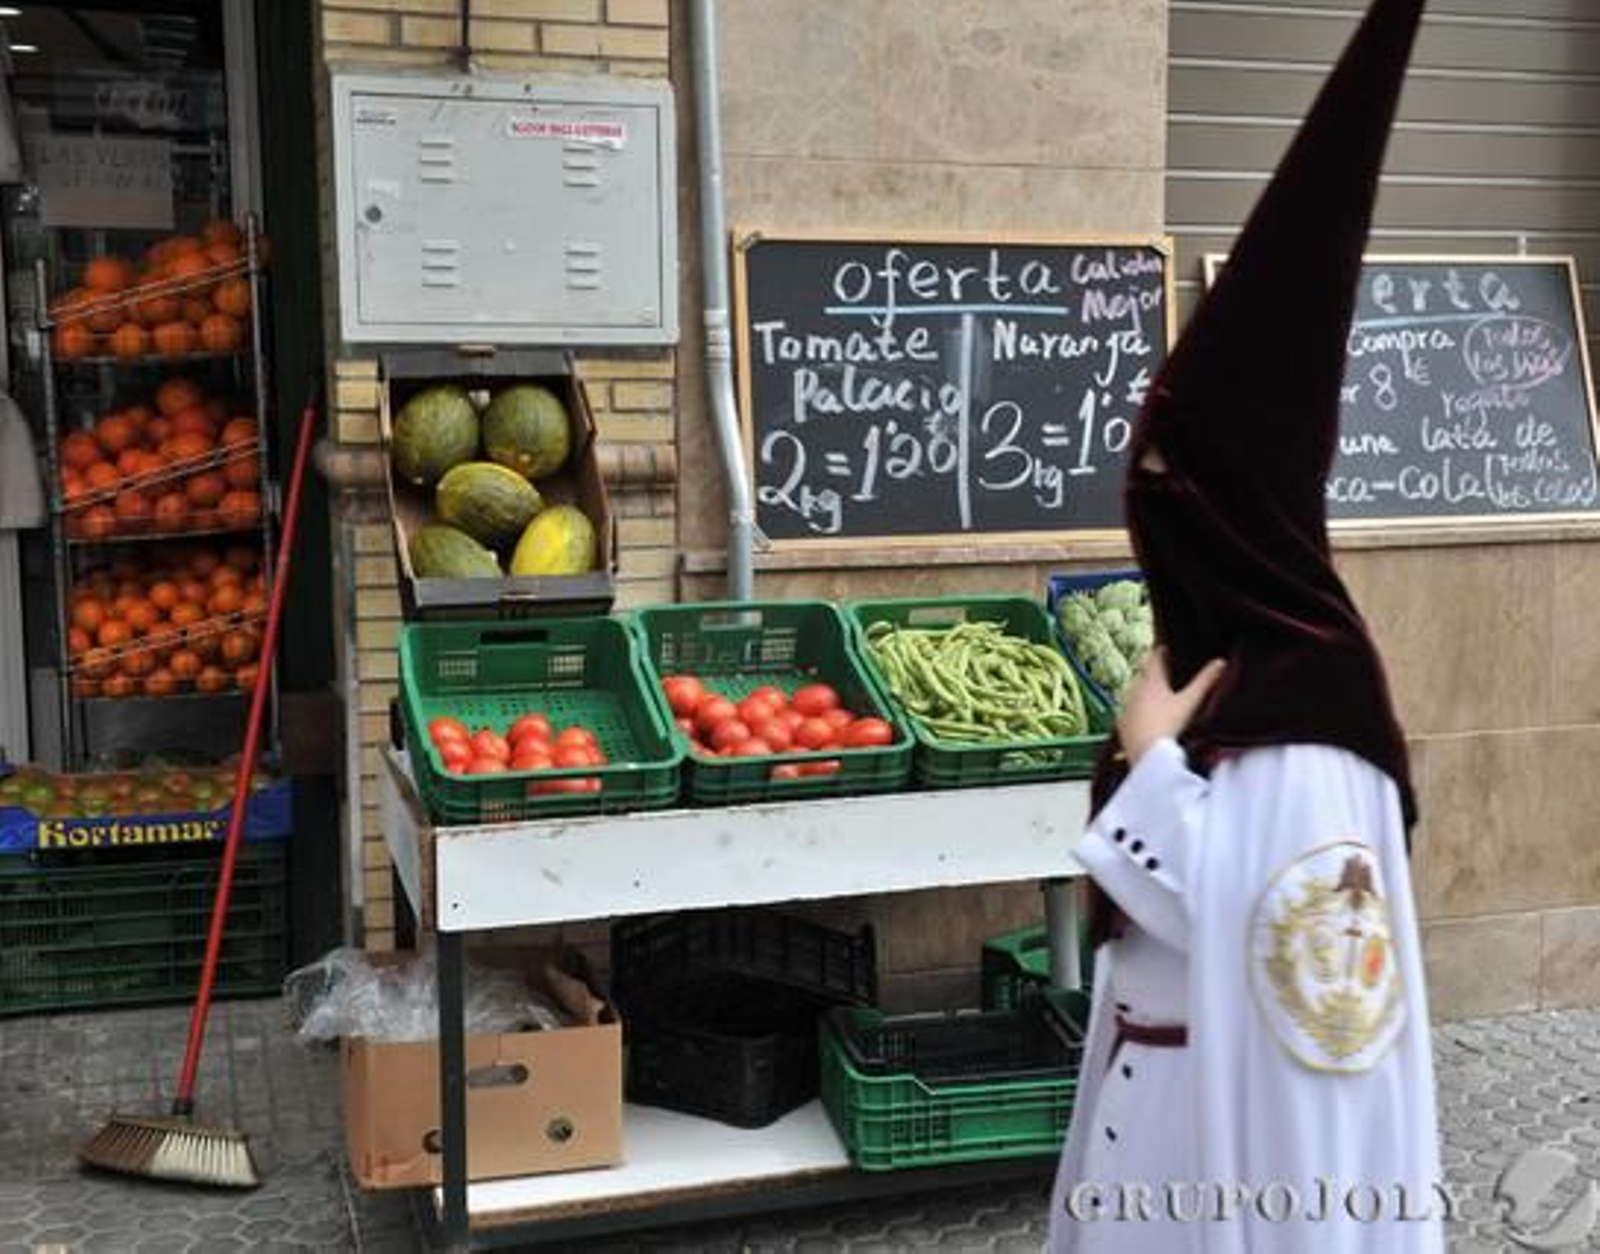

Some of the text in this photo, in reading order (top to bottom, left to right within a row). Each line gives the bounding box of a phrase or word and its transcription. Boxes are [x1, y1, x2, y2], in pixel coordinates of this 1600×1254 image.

[752, 320, 939, 364] Tomate
[792, 362, 963, 423] Palacio
[1421, 416, 1498, 452] lata
[1515, 413, 1558, 449] de
